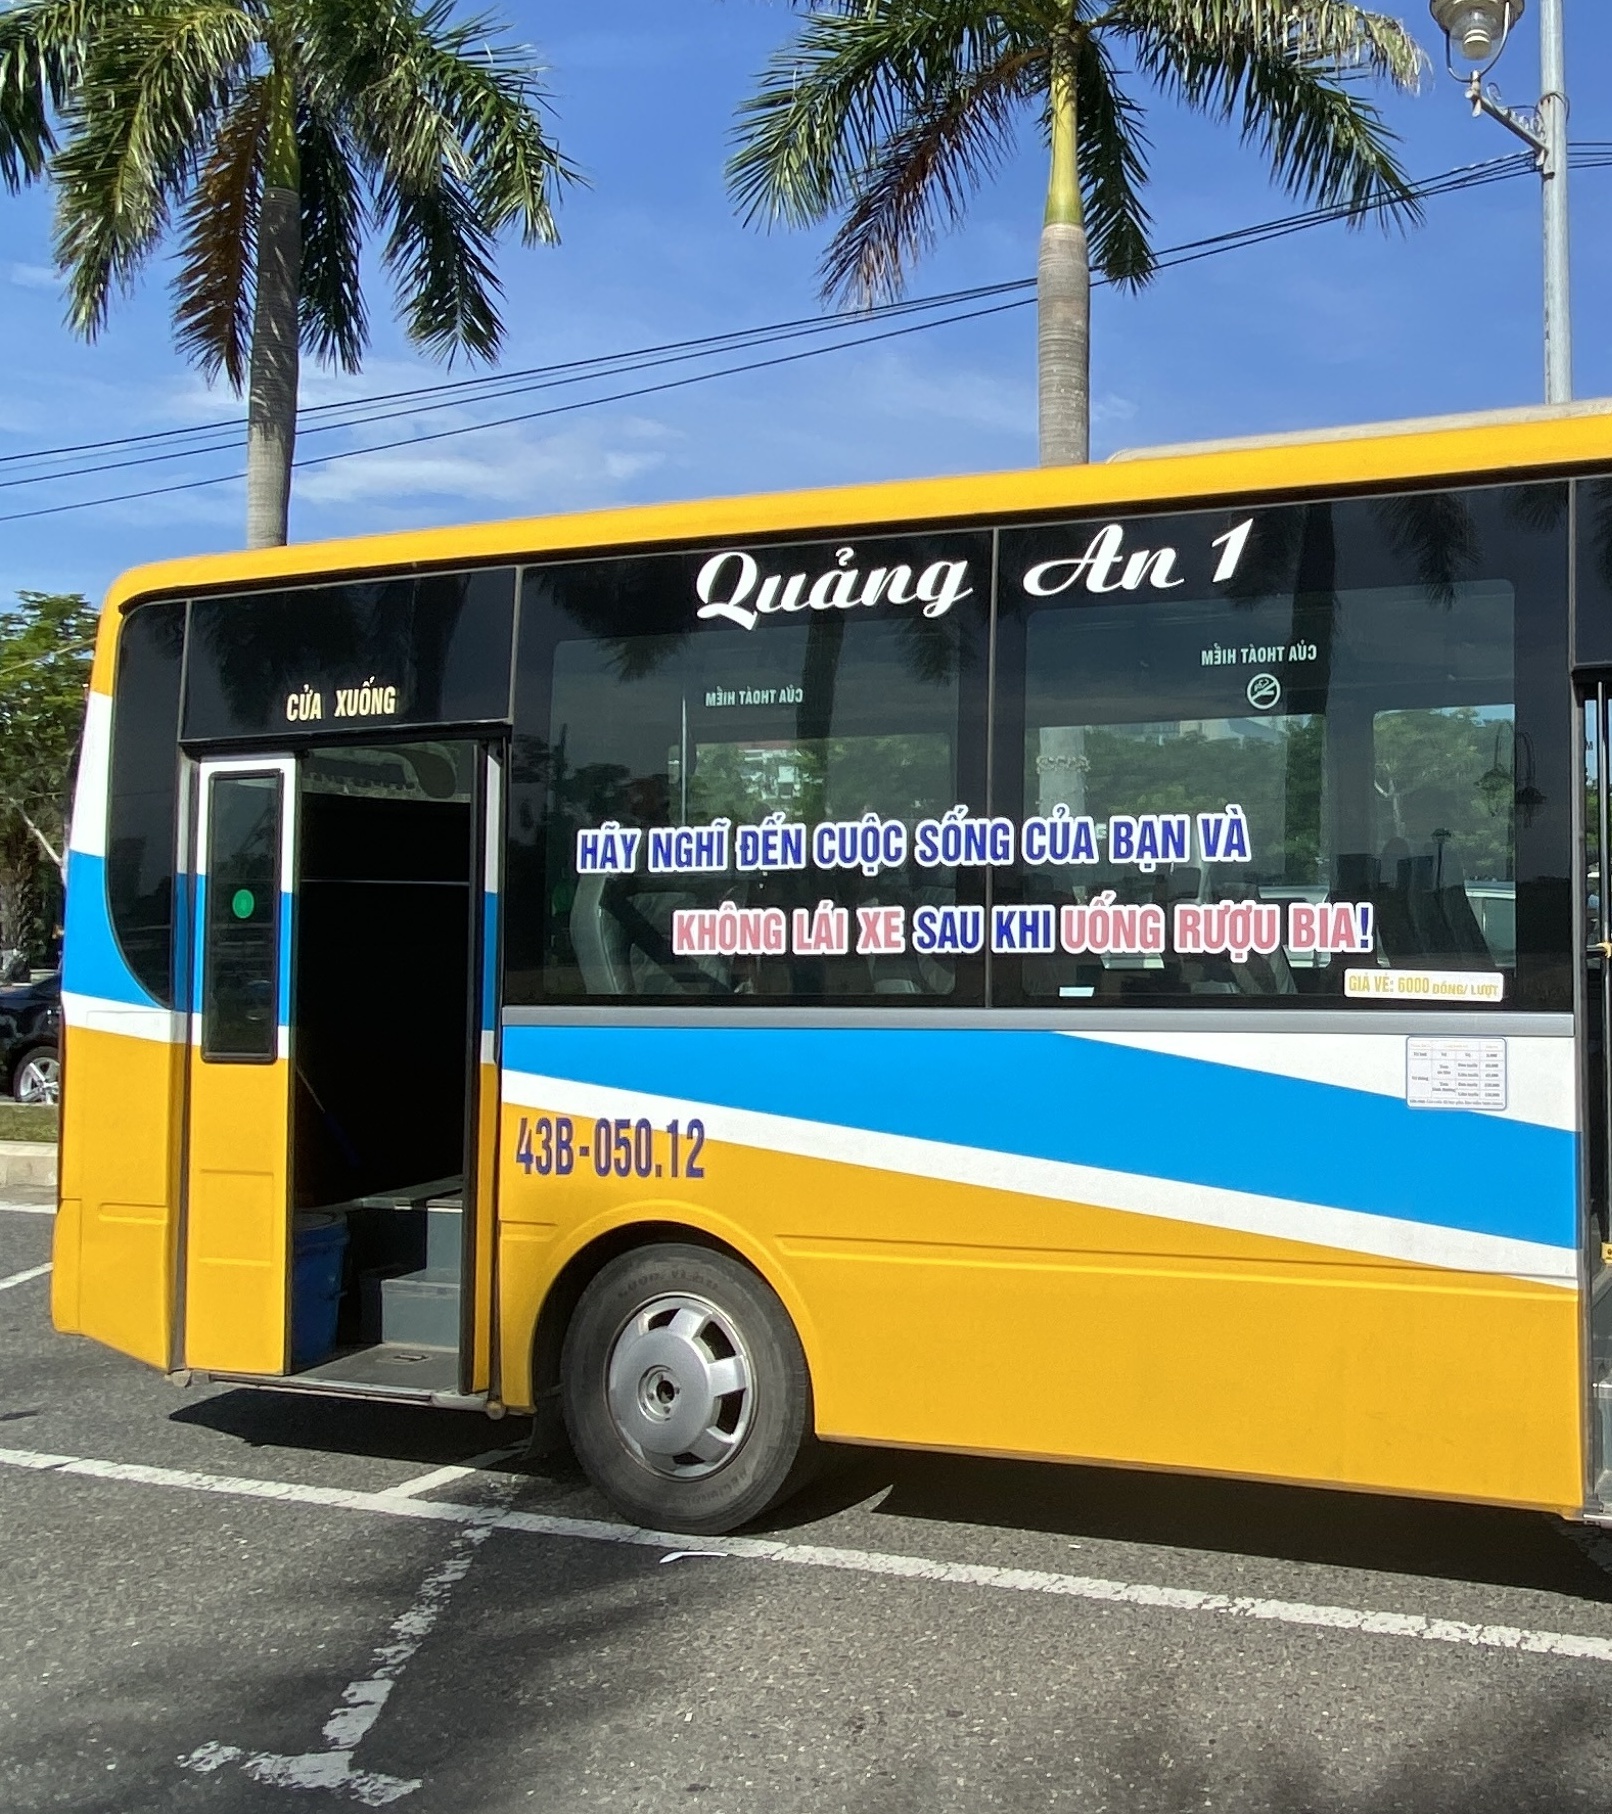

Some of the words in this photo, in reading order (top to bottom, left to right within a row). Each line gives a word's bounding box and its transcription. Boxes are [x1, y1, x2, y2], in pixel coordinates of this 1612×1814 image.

[696, 547, 973, 630] Quảng
[1023, 523, 1185, 597] An
[1211, 518, 1254, 583] 1
[286, 684, 322, 721] CỬA
[334, 676, 396, 717] XUỐNG
[579, 822, 640, 872] HÃY
[648, 818, 730, 872] NGHĨ
[736, 813, 806, 871] ĐẾN
[814, 813, 906, 876] CUỘC
[916, 806, 1014, 866] SỐNG
[1022, 804, 1099, 864] CỦA
[1109, 815, 1190, 872] BẠN
[1198, 804, 1252, 863] VÀ
[673, 902, 786, 954] KHÔNG
[792, 899, 848, 954] LÁI
[857, 906, 905, 954] XE
[913, 906, 984, 954] SAU
[992, 905, 1055, 953] KHI
[1060, 891, 1165, 954] UỐNG
[1174, 901, 1280, 962] RƯỢU
[1289, 902, 1374, 953] BIA!
[1398, 977, 1430, 994] 6000
[516, 1117, 705, 1178] 43B-050.12
